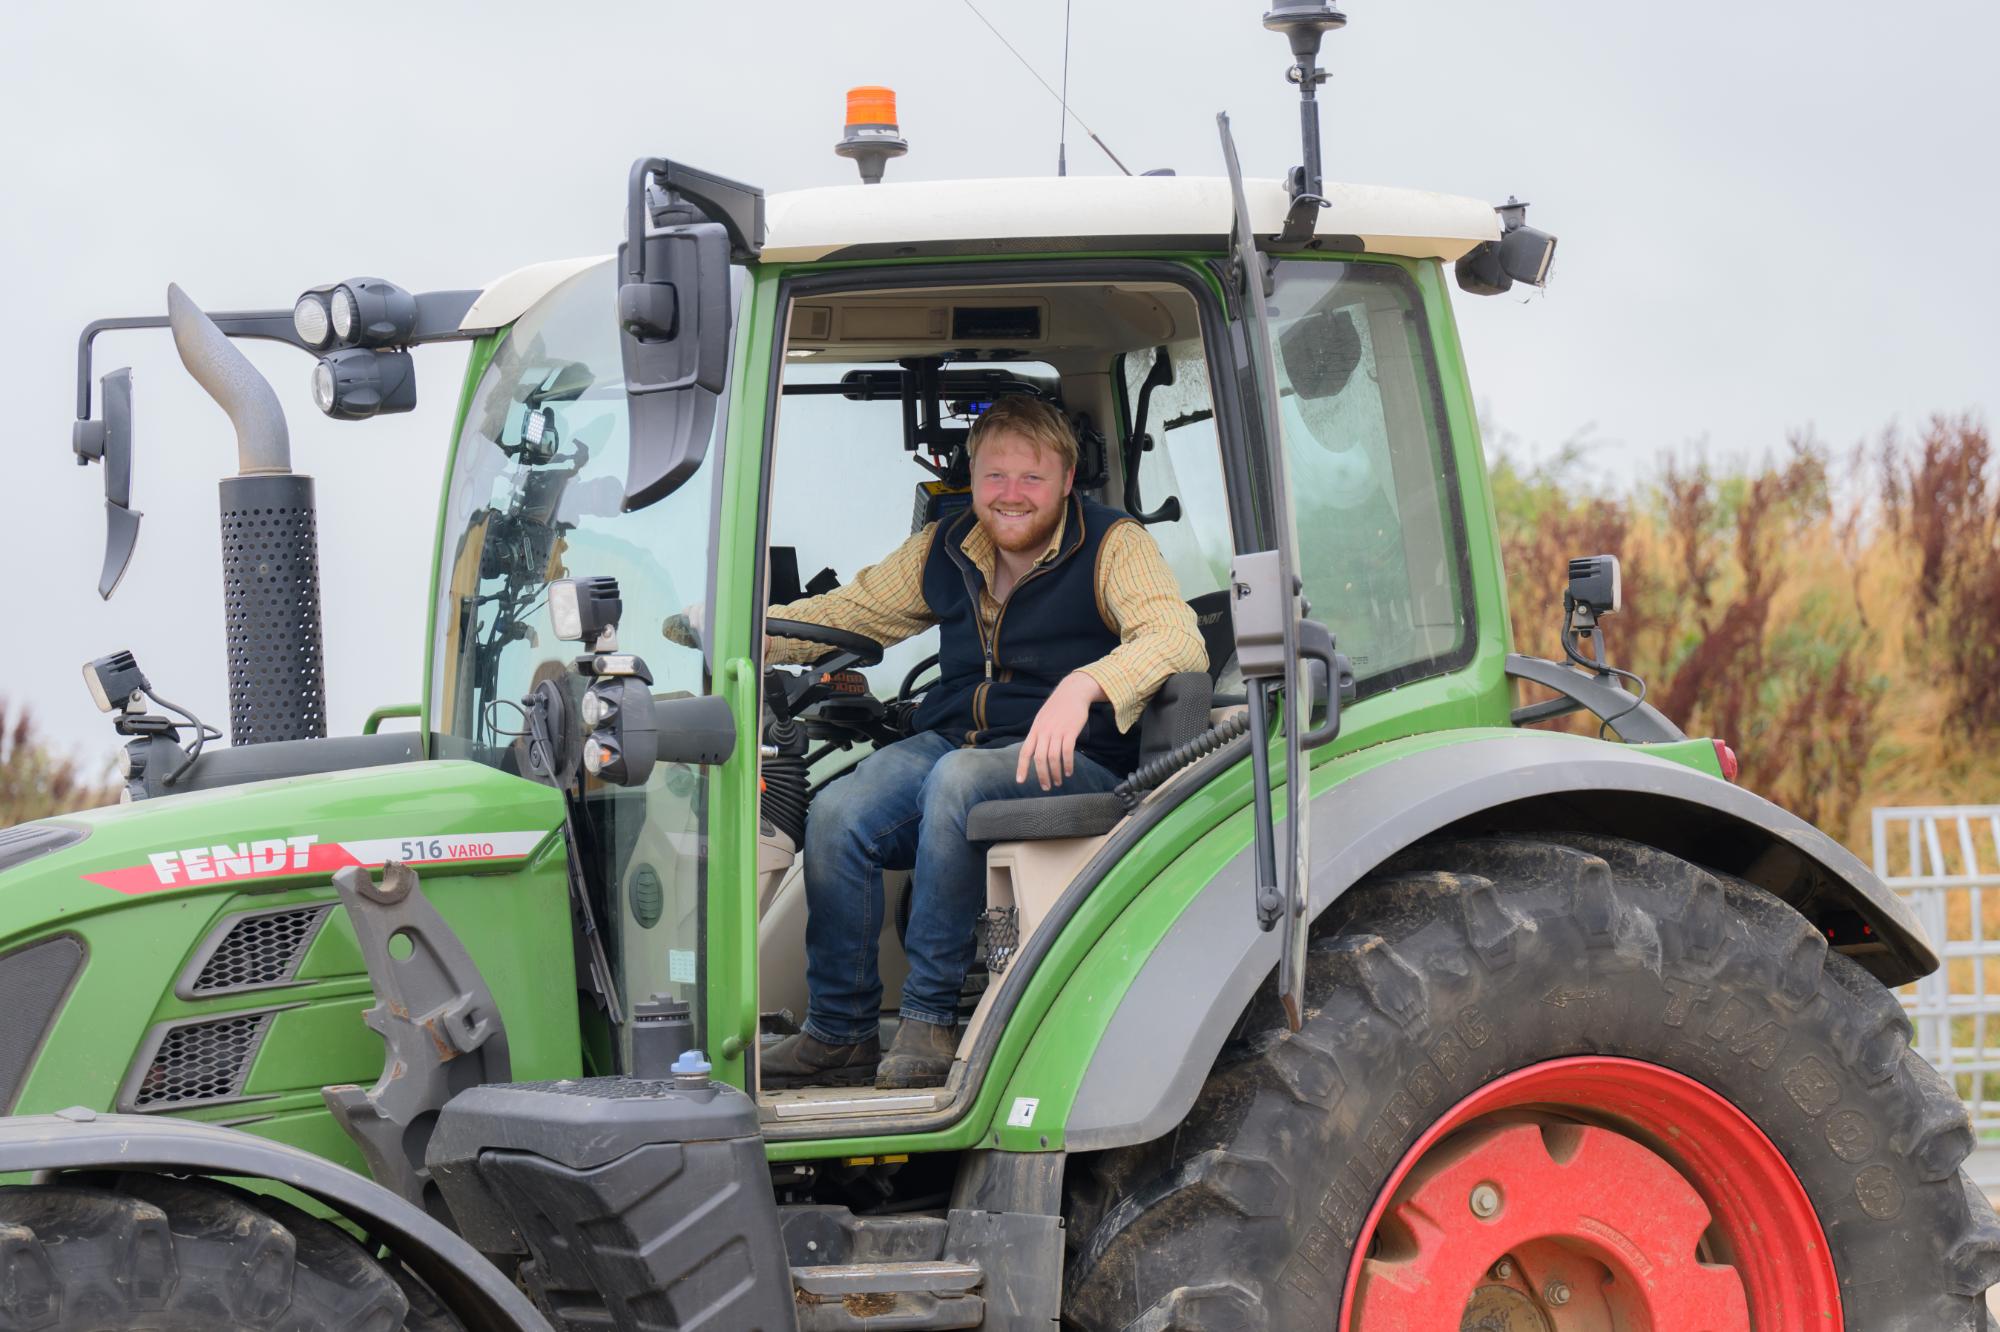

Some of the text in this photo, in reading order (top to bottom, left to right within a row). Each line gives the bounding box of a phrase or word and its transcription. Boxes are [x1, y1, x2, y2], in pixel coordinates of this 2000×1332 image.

[1197, 611, 1224, 626] ENDT
[148, 834, 318, 884] FENDT
[401, 840, 494, 861] 516 VARIO
[1275, 1004, 1491, 1299] TRELLEBORG
